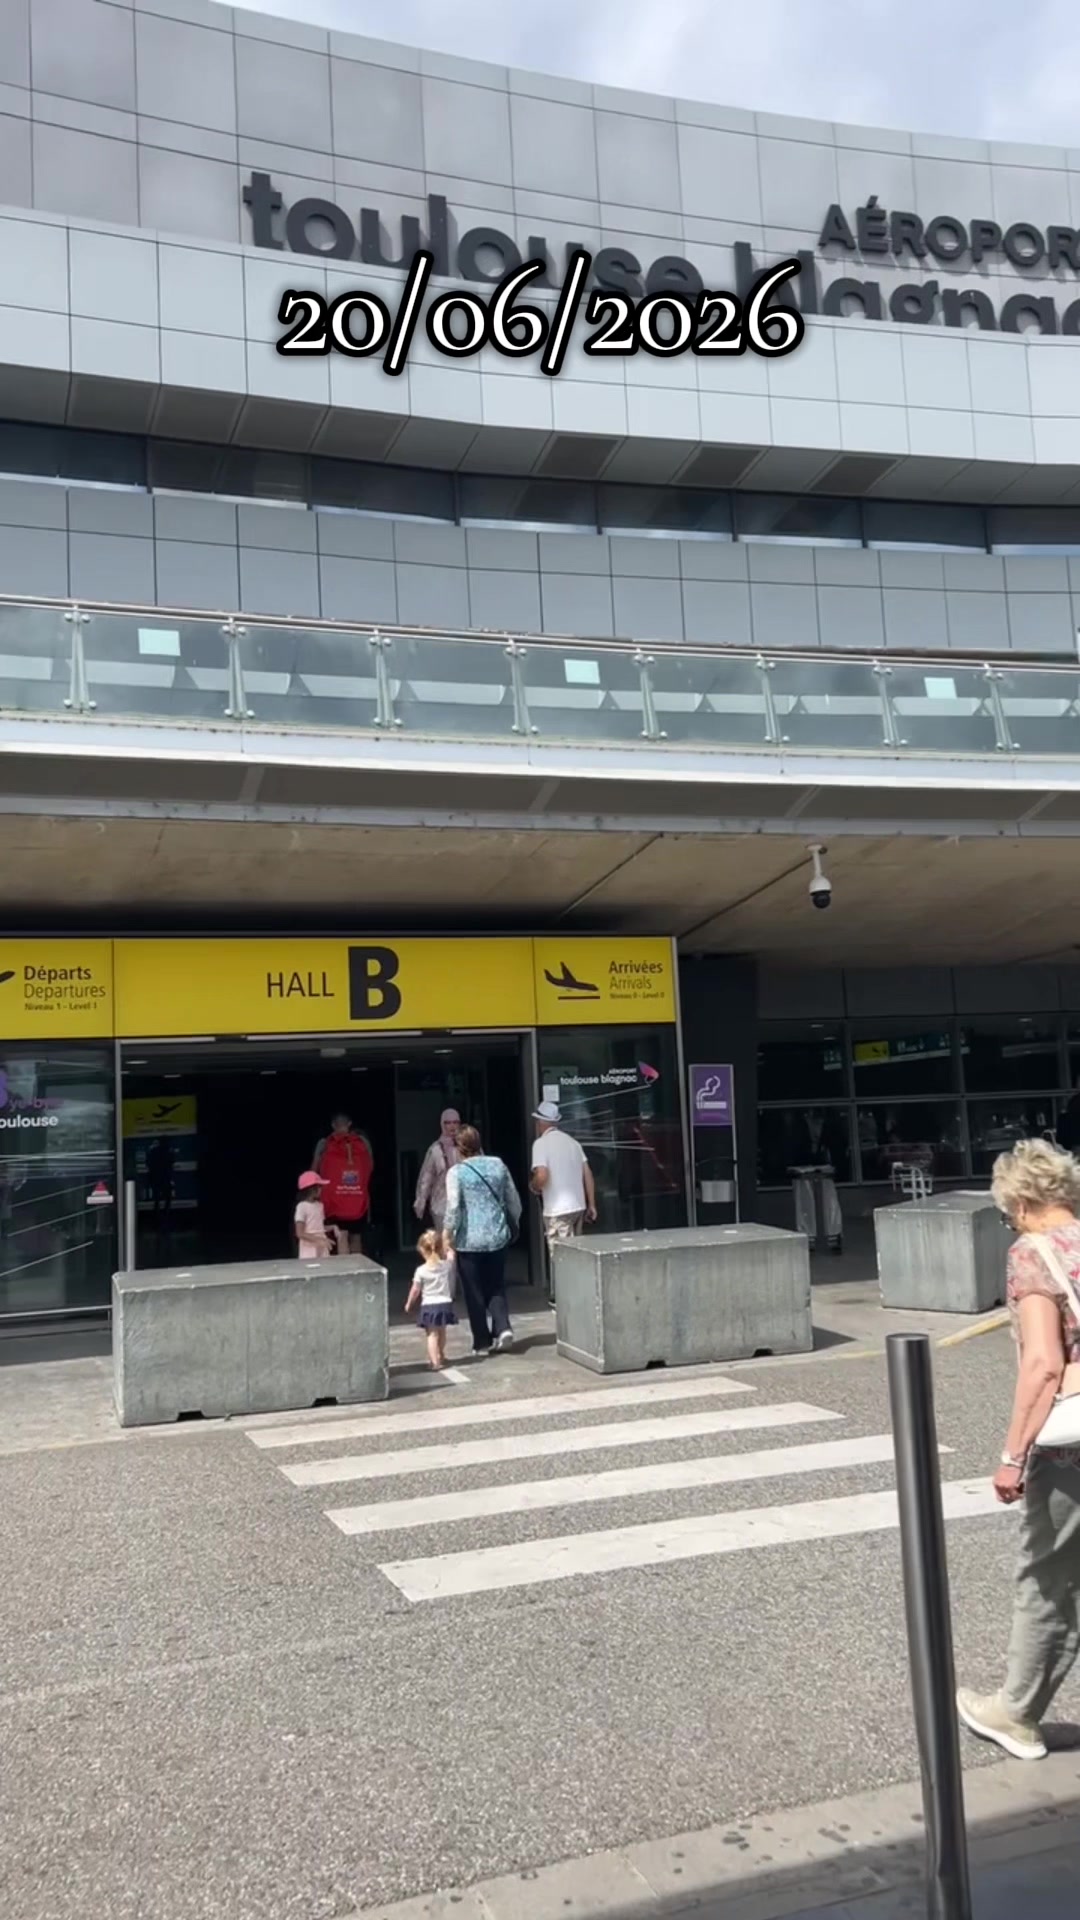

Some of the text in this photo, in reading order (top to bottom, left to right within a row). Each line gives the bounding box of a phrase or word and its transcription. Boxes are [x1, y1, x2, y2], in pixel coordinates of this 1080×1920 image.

[818, 195, 1080, 270] AÉROPOR
[23, 965, 92, 984] Départs
[608, 960, 664, 974] Arrivées
[266, 946, 402, 1020] HALL B
[609, 975, 652, 990] Arrivals
[23, 983, 106, 1001] Departures
[560, 1073, 638, 1086] toulouse blagnac
